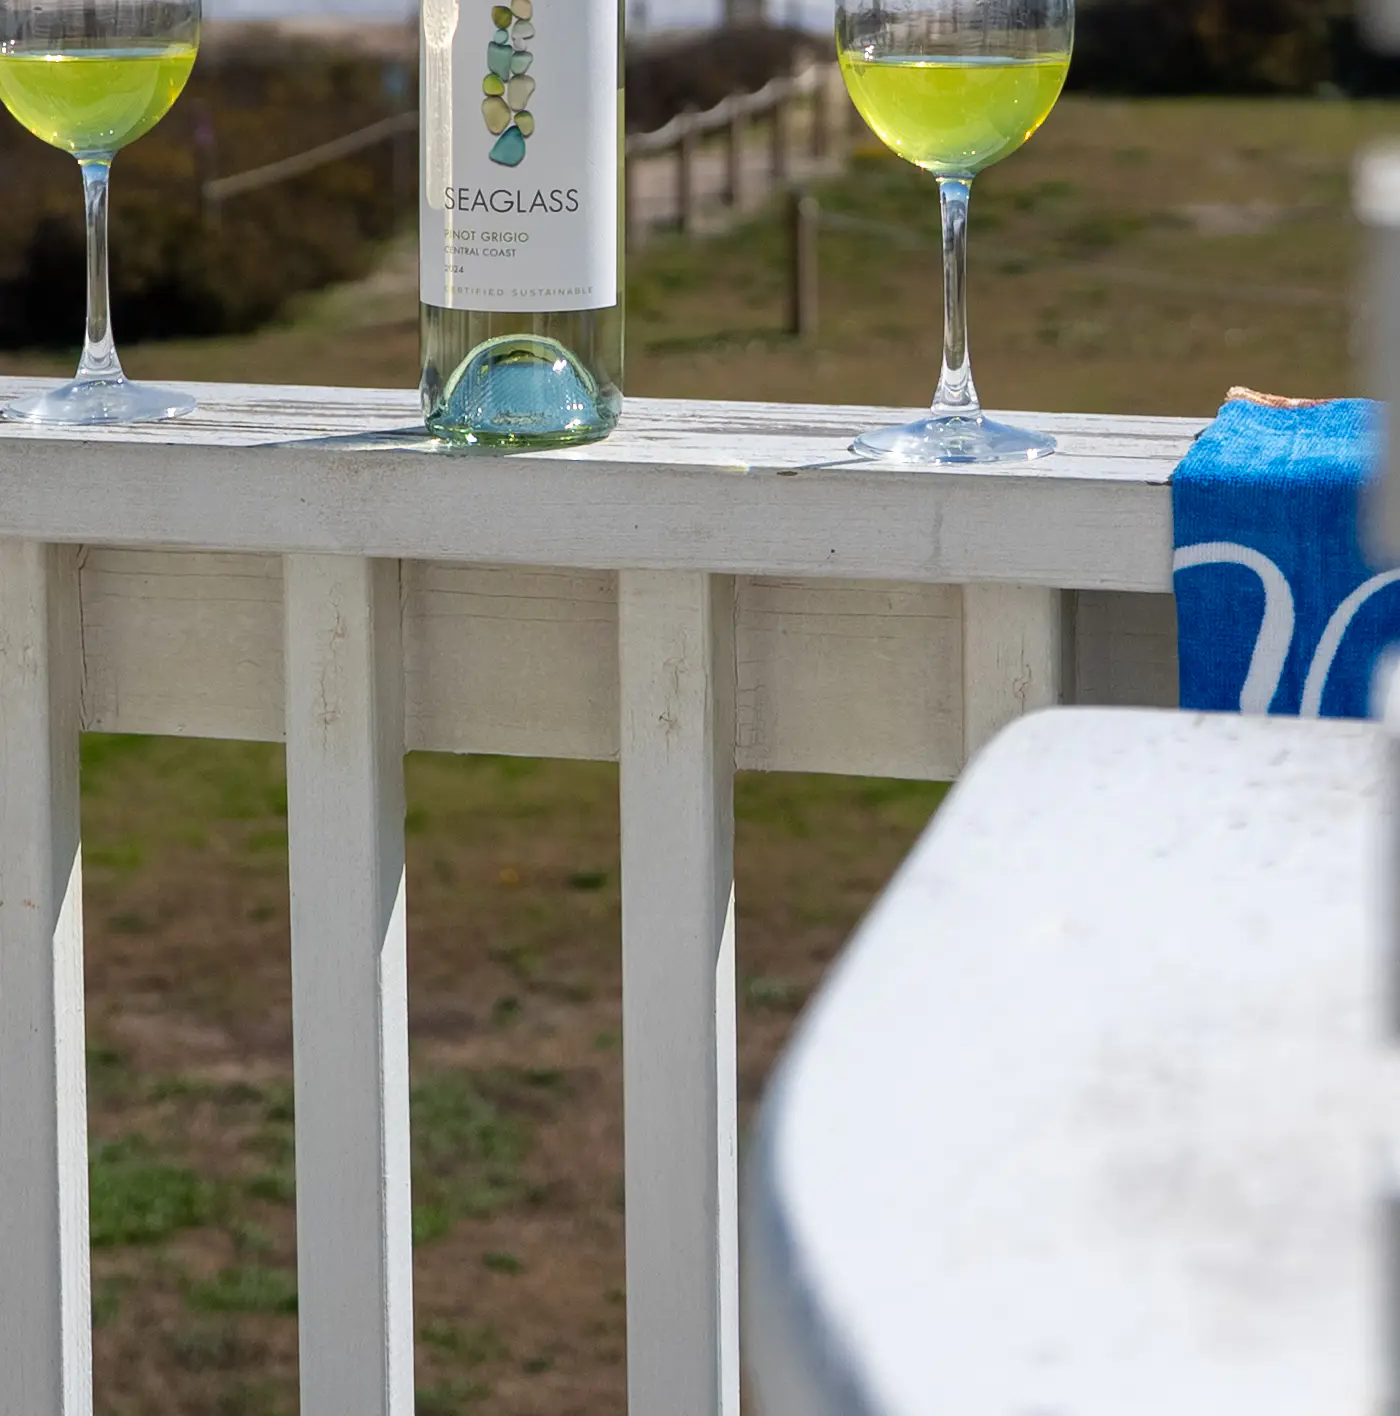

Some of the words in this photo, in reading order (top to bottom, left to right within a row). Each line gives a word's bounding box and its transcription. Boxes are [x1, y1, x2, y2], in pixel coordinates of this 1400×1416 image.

[444, 187, 579, 213] SEAGLASS
[480, 231, 529, 243] GRIGIO
[444, 245, 480, 257] CENTRAL
[482, 248, 516, 258] COAST
[511, 286, 594, 298] SUSTAINABLE
